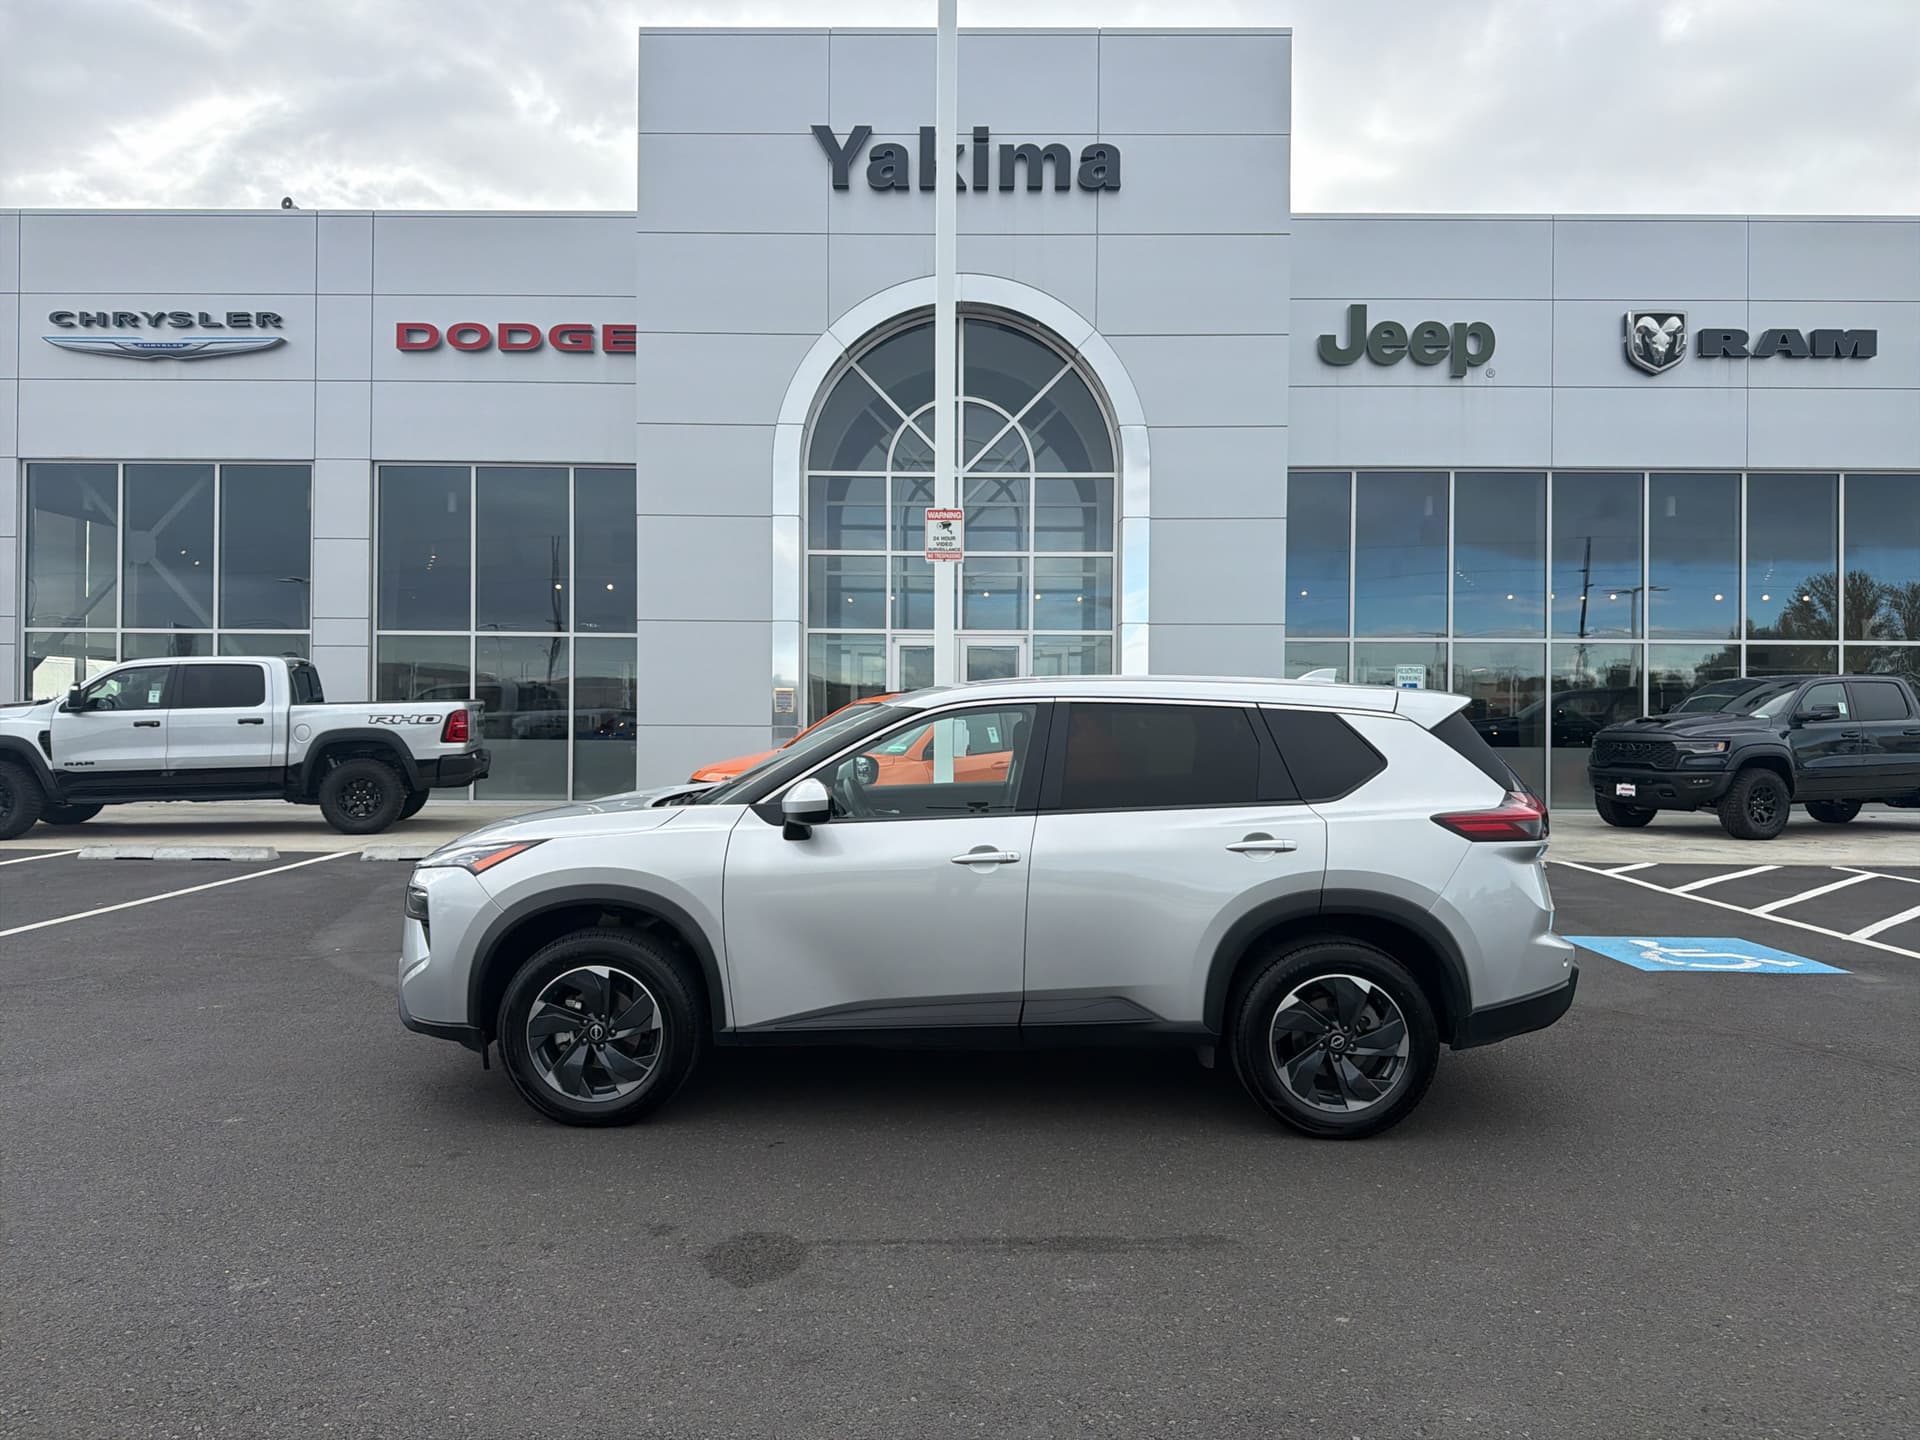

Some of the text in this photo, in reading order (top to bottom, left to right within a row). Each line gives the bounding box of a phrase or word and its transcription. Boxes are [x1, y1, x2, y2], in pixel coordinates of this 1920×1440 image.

[810, 125, 1121, 191] Yakima
[49, 310, 284, 329] CHRYSLER
[396, 322, 637, 354] DODGE
[1317, 303, 1496, 378] Jeep
[1697, 328, 1878, 359] RAM
[928, 511, 962, 519] WARNING
[368, 714, 443, 725] RHO
